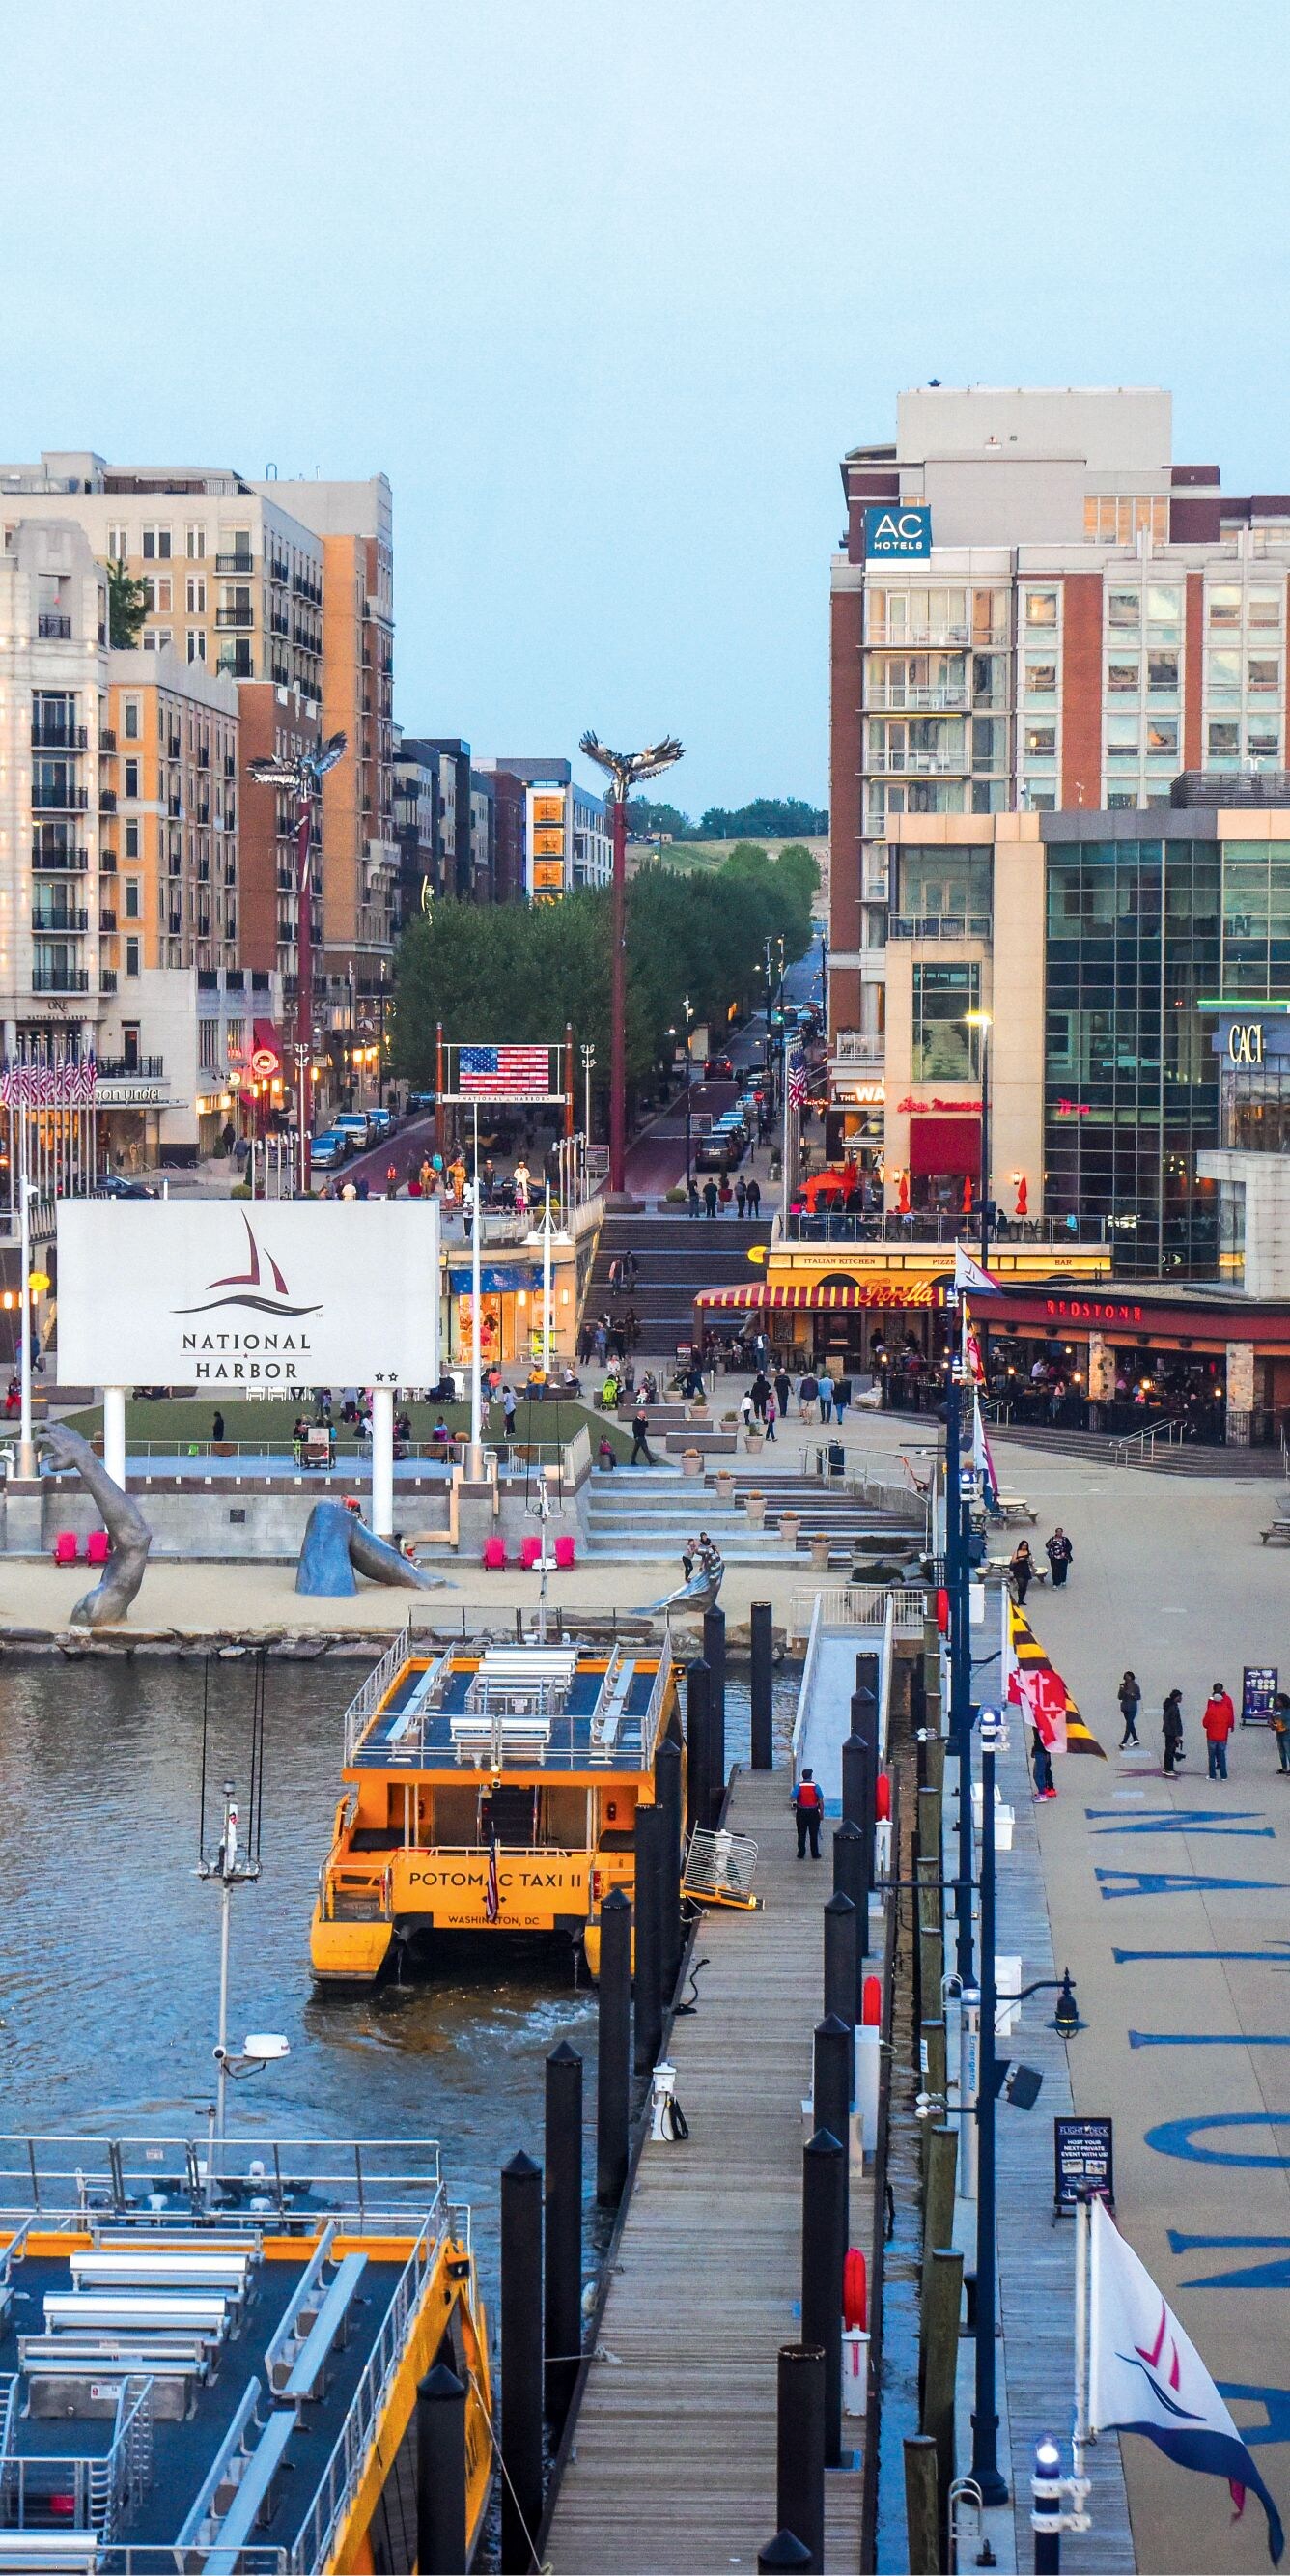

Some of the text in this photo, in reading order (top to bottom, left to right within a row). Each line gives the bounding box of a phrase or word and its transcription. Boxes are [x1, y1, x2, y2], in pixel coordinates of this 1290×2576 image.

[874, 514, 923, 539] AC
[874, 541, 923, 550] HOTELS
[1229, 1024, 1263, 1062] CACI
[94, 1086, 162, 1100] oon under
[855, 1086, 885, 1102] WA
[858, 1278, 935, 1303] Fiorella
[1047, 1299, 1142, 1321] REDSTONE
[182, 1333, 311, 1350] NATIONAL
[195, 1362, 297, 1378] HARBOR
[409, 1872, 581, 1887] POTOMC TAXI II
[448, 1915, 540, 1927] WASHINTON, DC
[968, 2035, 977, 2092] Emergency
